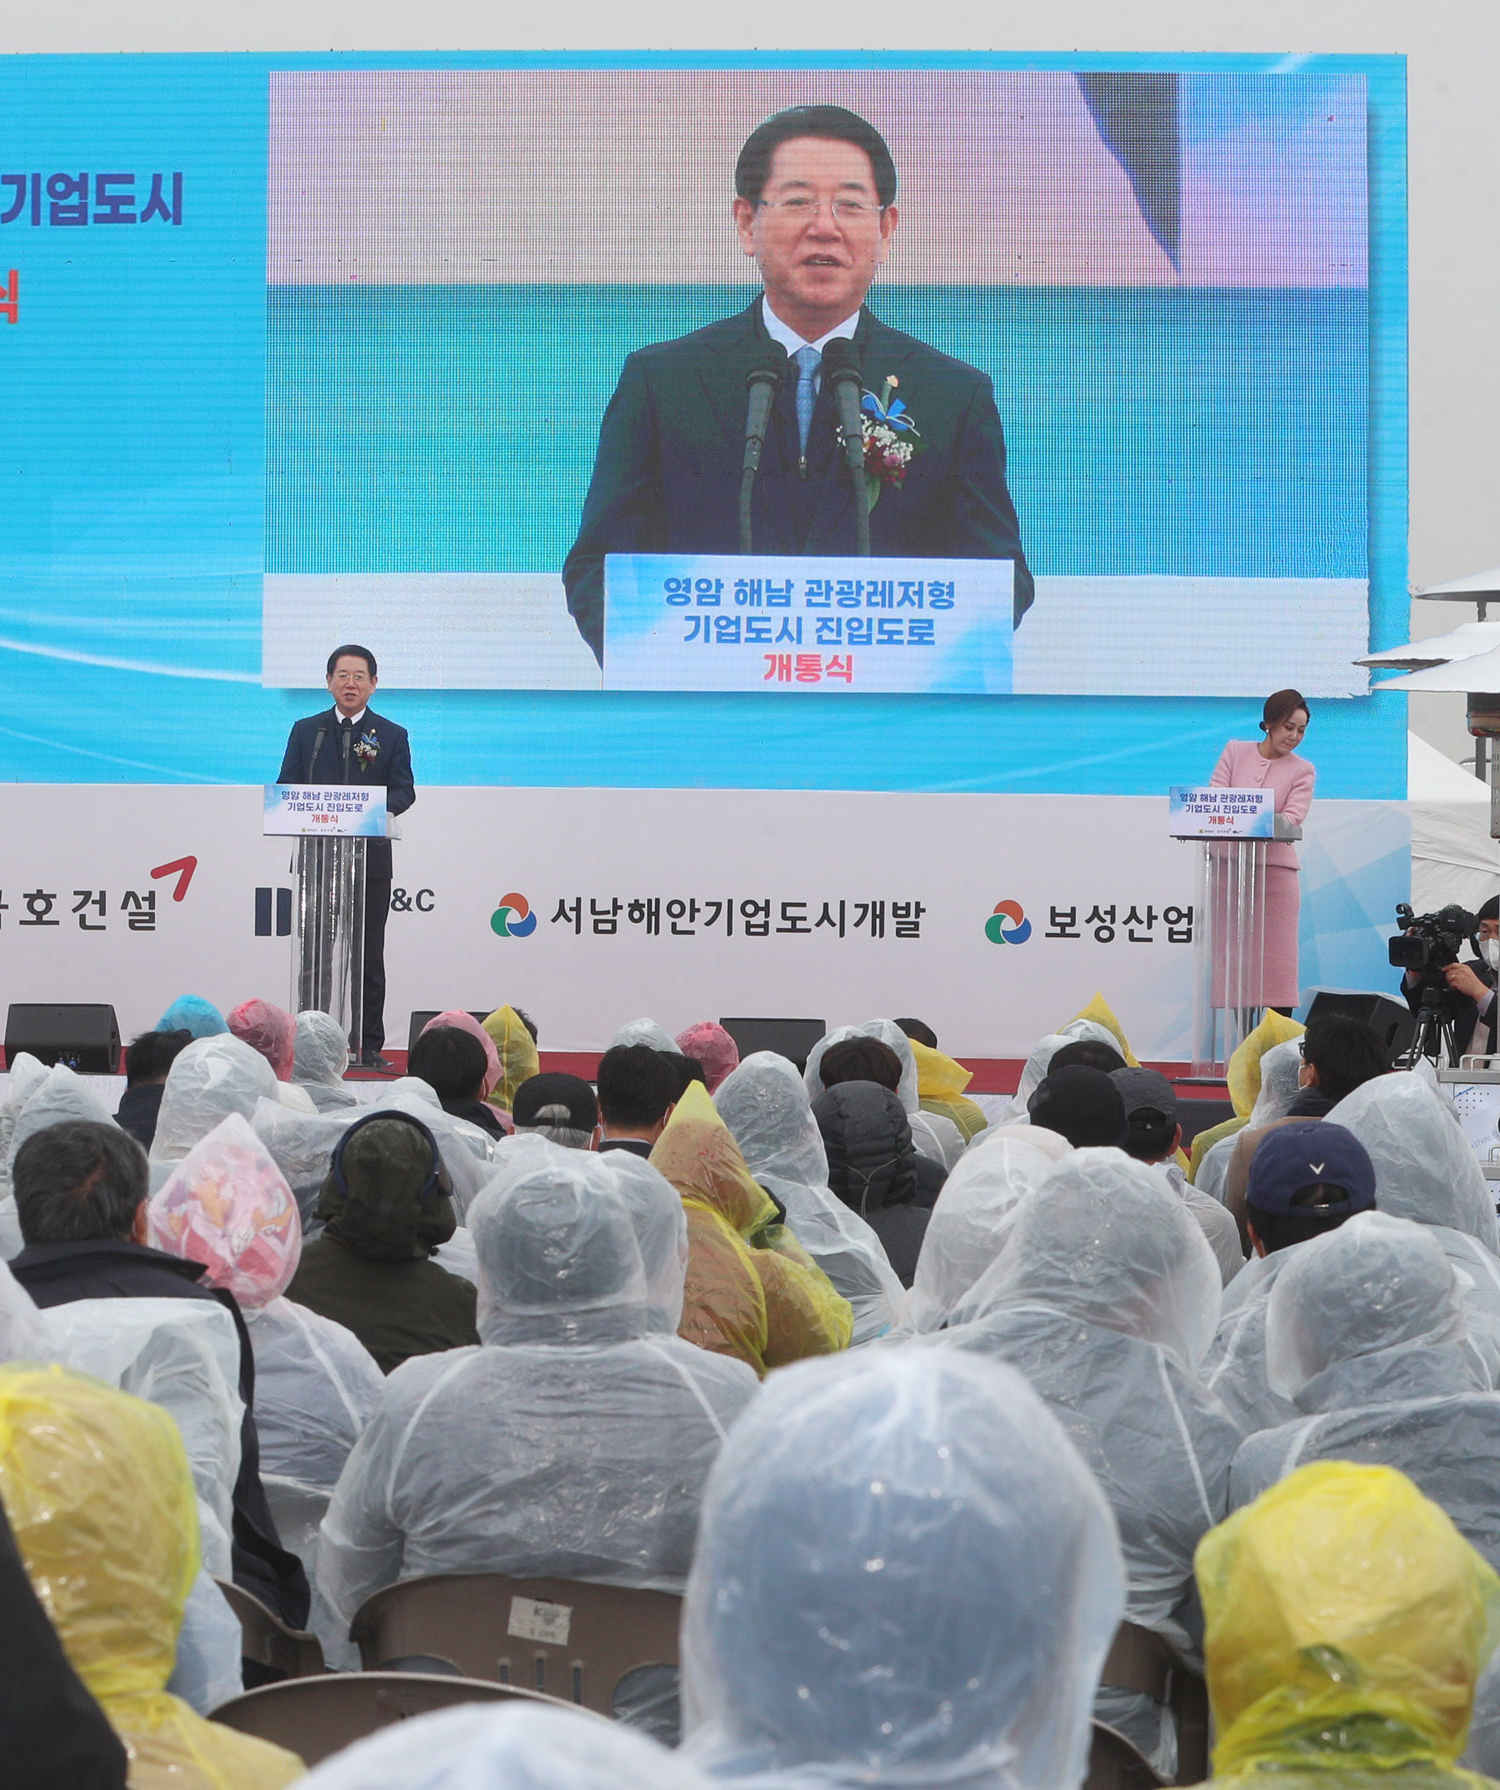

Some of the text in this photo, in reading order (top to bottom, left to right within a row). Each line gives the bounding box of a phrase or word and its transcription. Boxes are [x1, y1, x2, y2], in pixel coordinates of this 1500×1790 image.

[0, 172, 184, 227] 기업도시
[662, 577, 957, 611] 영암 해남 관광레저형
[683, 615, 937, 648] 기업도시 진입도로
[762, 653, 854, 685] 개통식
[287, 803, 364, 813] 기업도시 진입도로
[302, 791, 321, 801] 해남
[1185, 804, 1258, 815] 기업도시 진입도로
[1200, 793, 1217, 803] 해남
[390, 887, 436, 912] &C
[551, 896, 928, 940] 서남해안기업도시개발
[1045, 905, 1194, 944] 보성산업
